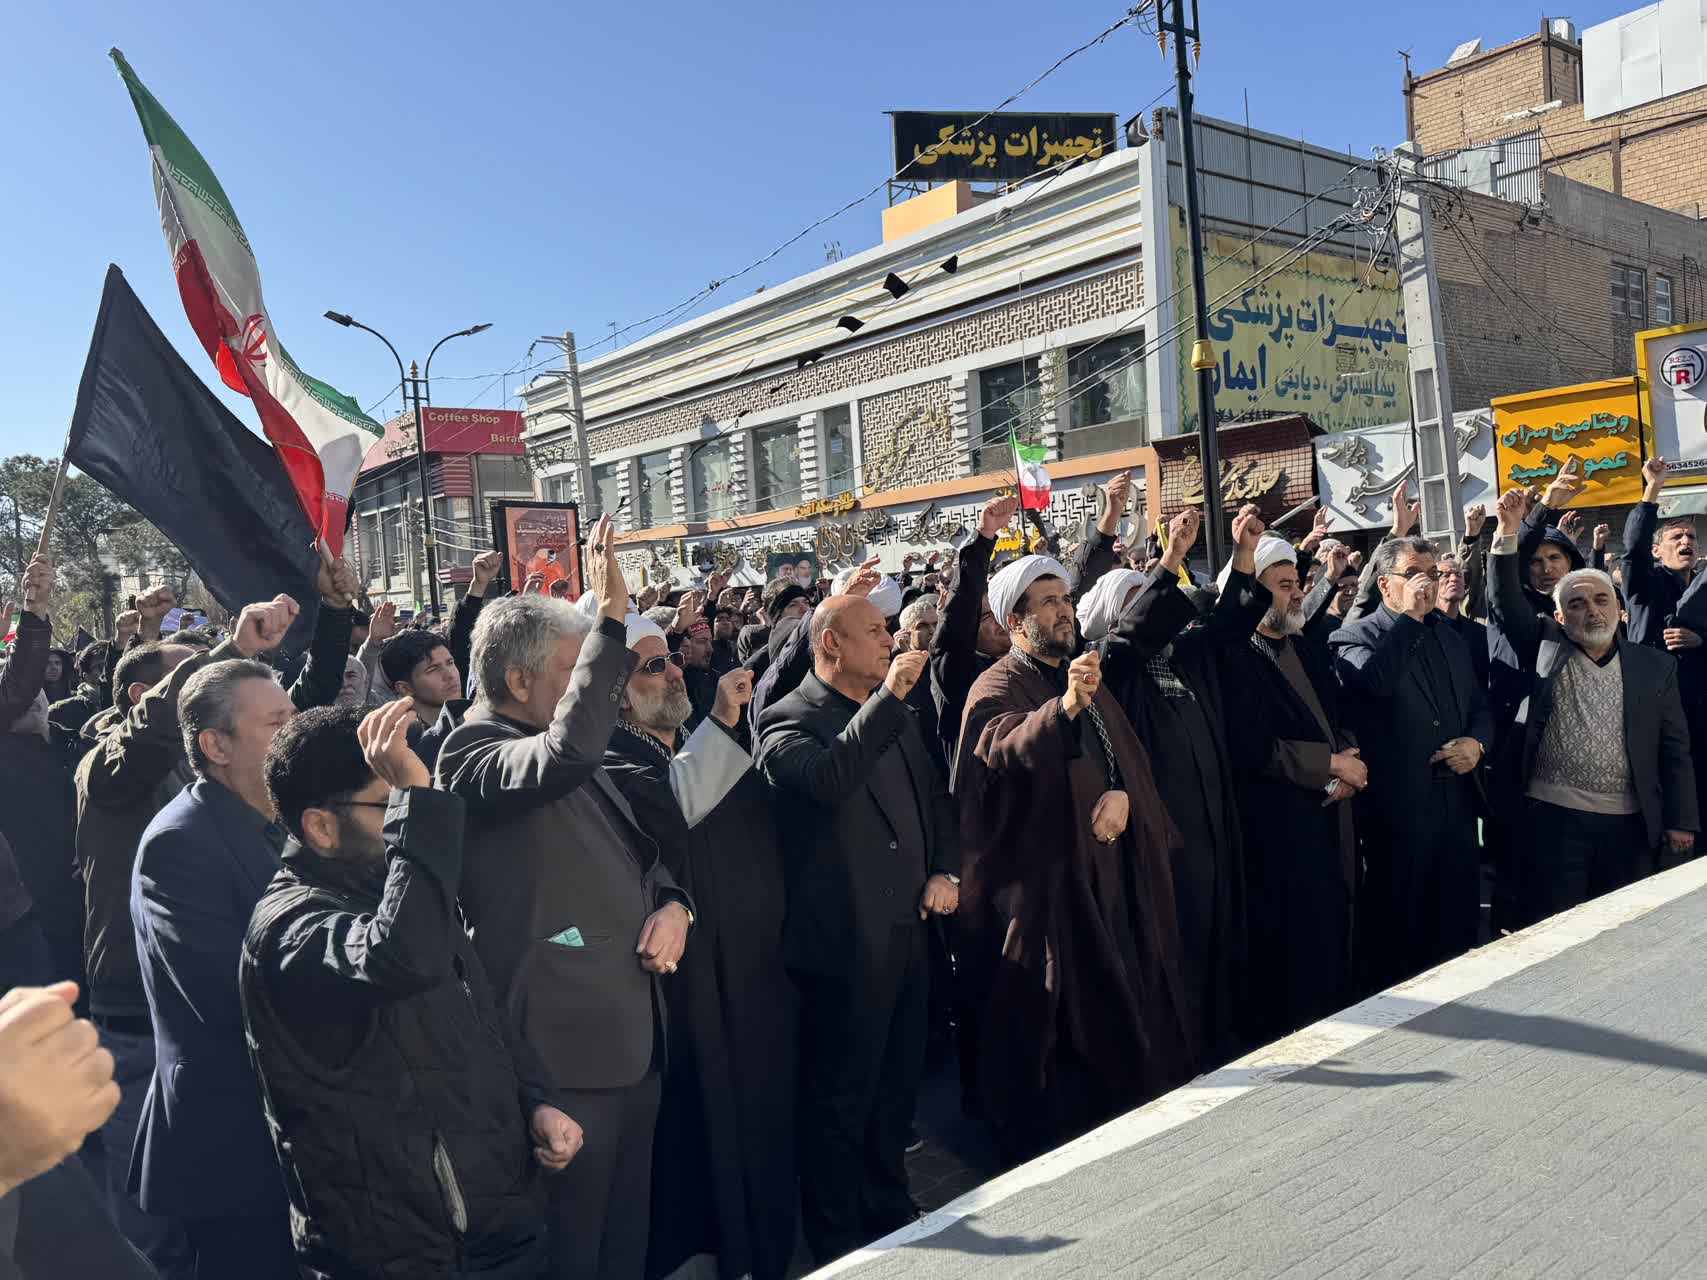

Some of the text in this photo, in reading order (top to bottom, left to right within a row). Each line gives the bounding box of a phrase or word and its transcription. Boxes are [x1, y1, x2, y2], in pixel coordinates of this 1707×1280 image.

[914, 124, 997, 168] پزشکی
[1207, 285, 1293, 349] پزشکی
[1668, 354, 1696, 364] REZA
[1676, 369, 1691, 385] R
[428, 412, 501, 425] Coffee Shop
[1551, 412, 1630, 441] ویتامین
[1501, 424, 1549, 448] سرای
[1584, 451, 1628, 479] عمو
